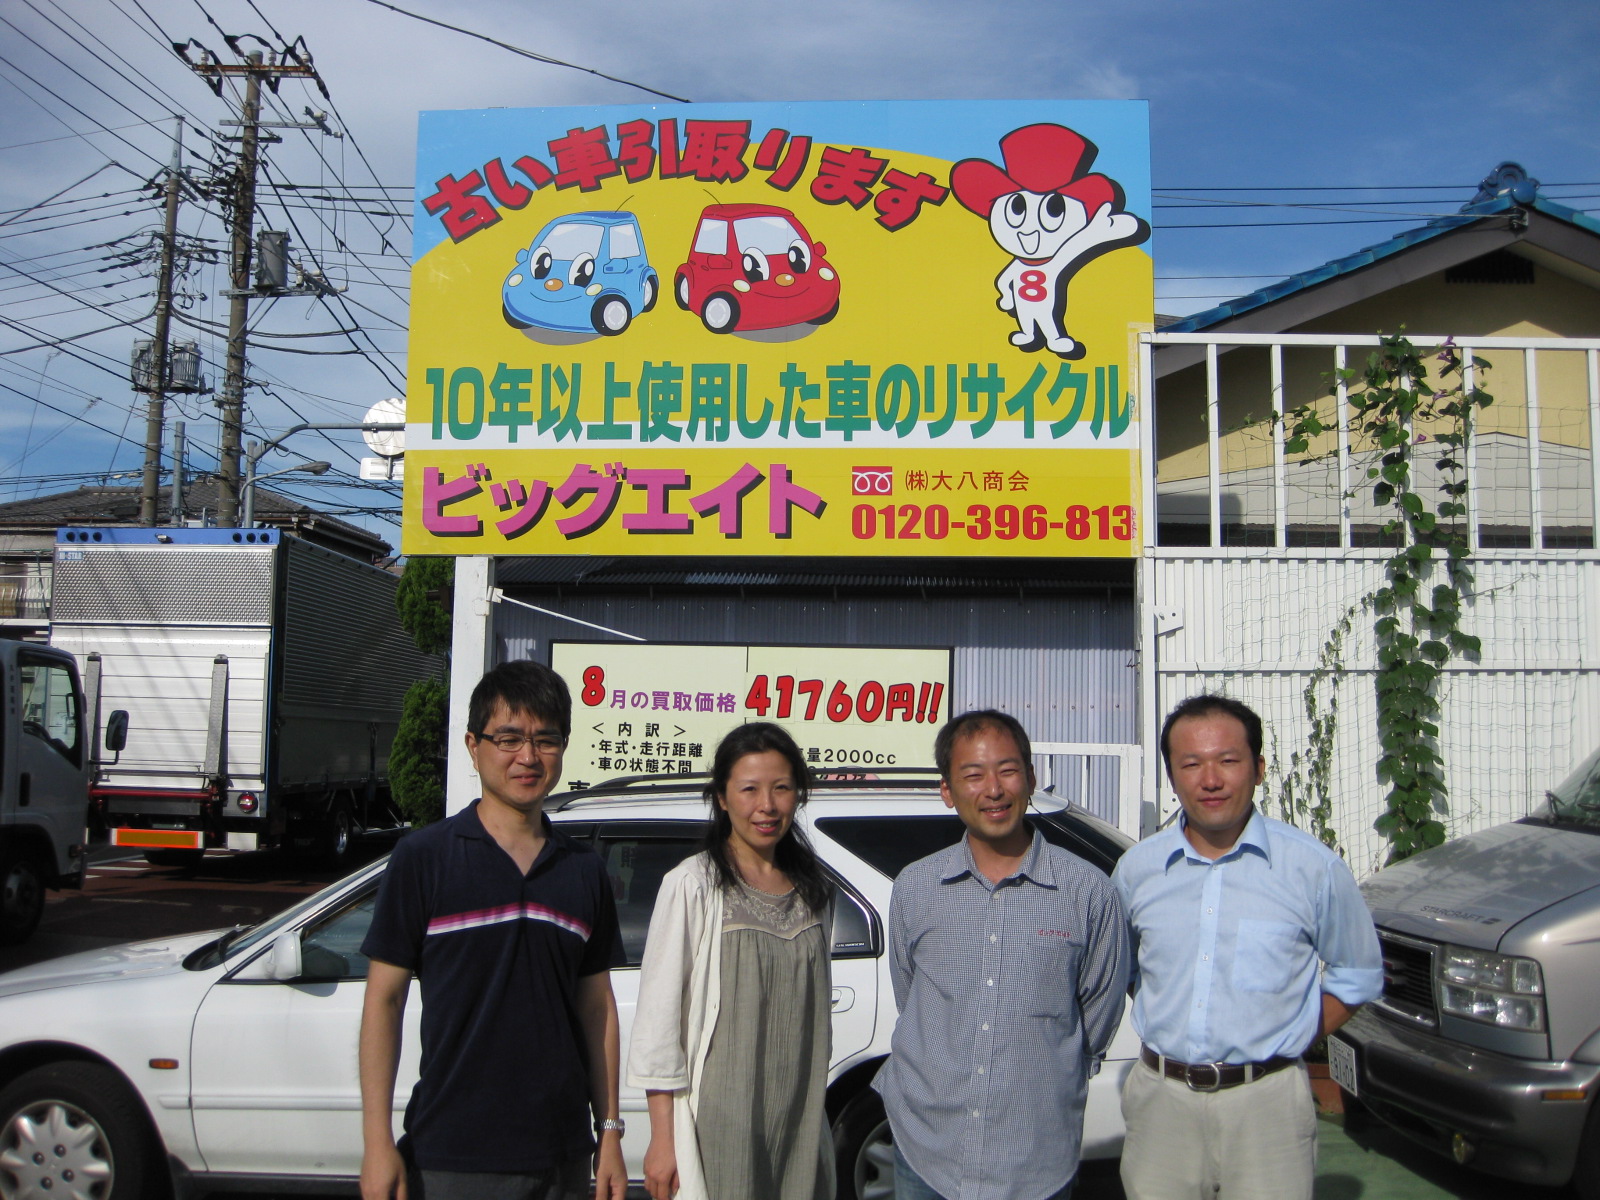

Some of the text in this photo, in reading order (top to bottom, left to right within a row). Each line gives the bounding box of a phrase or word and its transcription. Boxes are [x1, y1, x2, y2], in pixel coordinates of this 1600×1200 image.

[420, 117, 951, 244] 古い車引取ります
[1018, 269, 1048, 303] 8
[425, 360, 1131, 443] 10年以上使用した車のリサイクル
[422, 461, 828, 541] ビッグエイト
[851, 503, 1134, 541] 0120-396-813
[799, 747, 897, 765] 量2000cc
[1420, 905, 1486, 922] STARCRAFT
